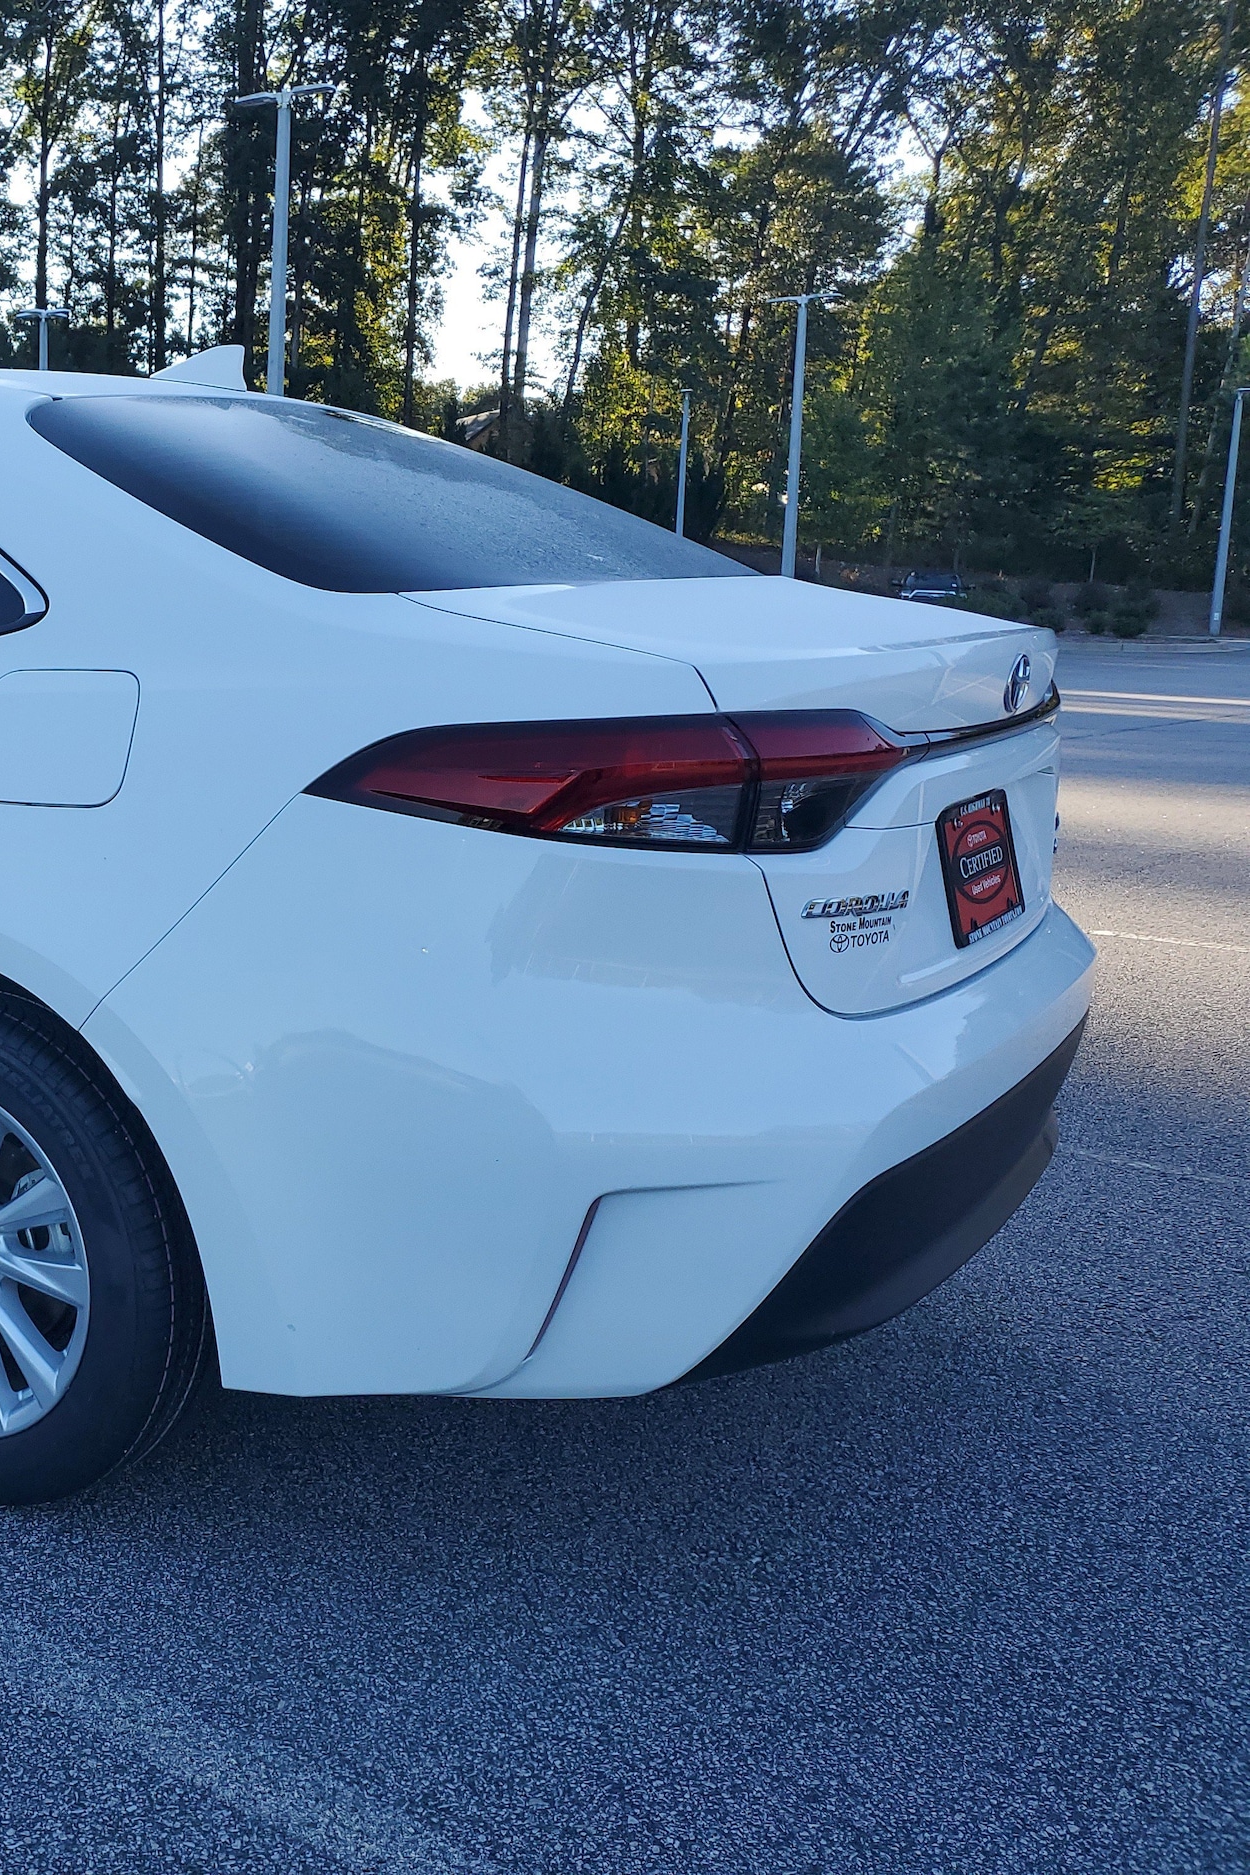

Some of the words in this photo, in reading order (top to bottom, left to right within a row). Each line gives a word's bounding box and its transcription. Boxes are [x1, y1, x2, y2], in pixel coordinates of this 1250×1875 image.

[959, 845, 1004, 879] CERTIFIED
[971, 881, 983, 895] Used
[982, 874, 1002, 890] Vehicles
[800, 889, 911, 919] COROLLA
[830, 920, 858, 934] STONE
[858, 916, 892, 931] MOUNTAIN
[851, 930, 890, 948] TOYOTA
